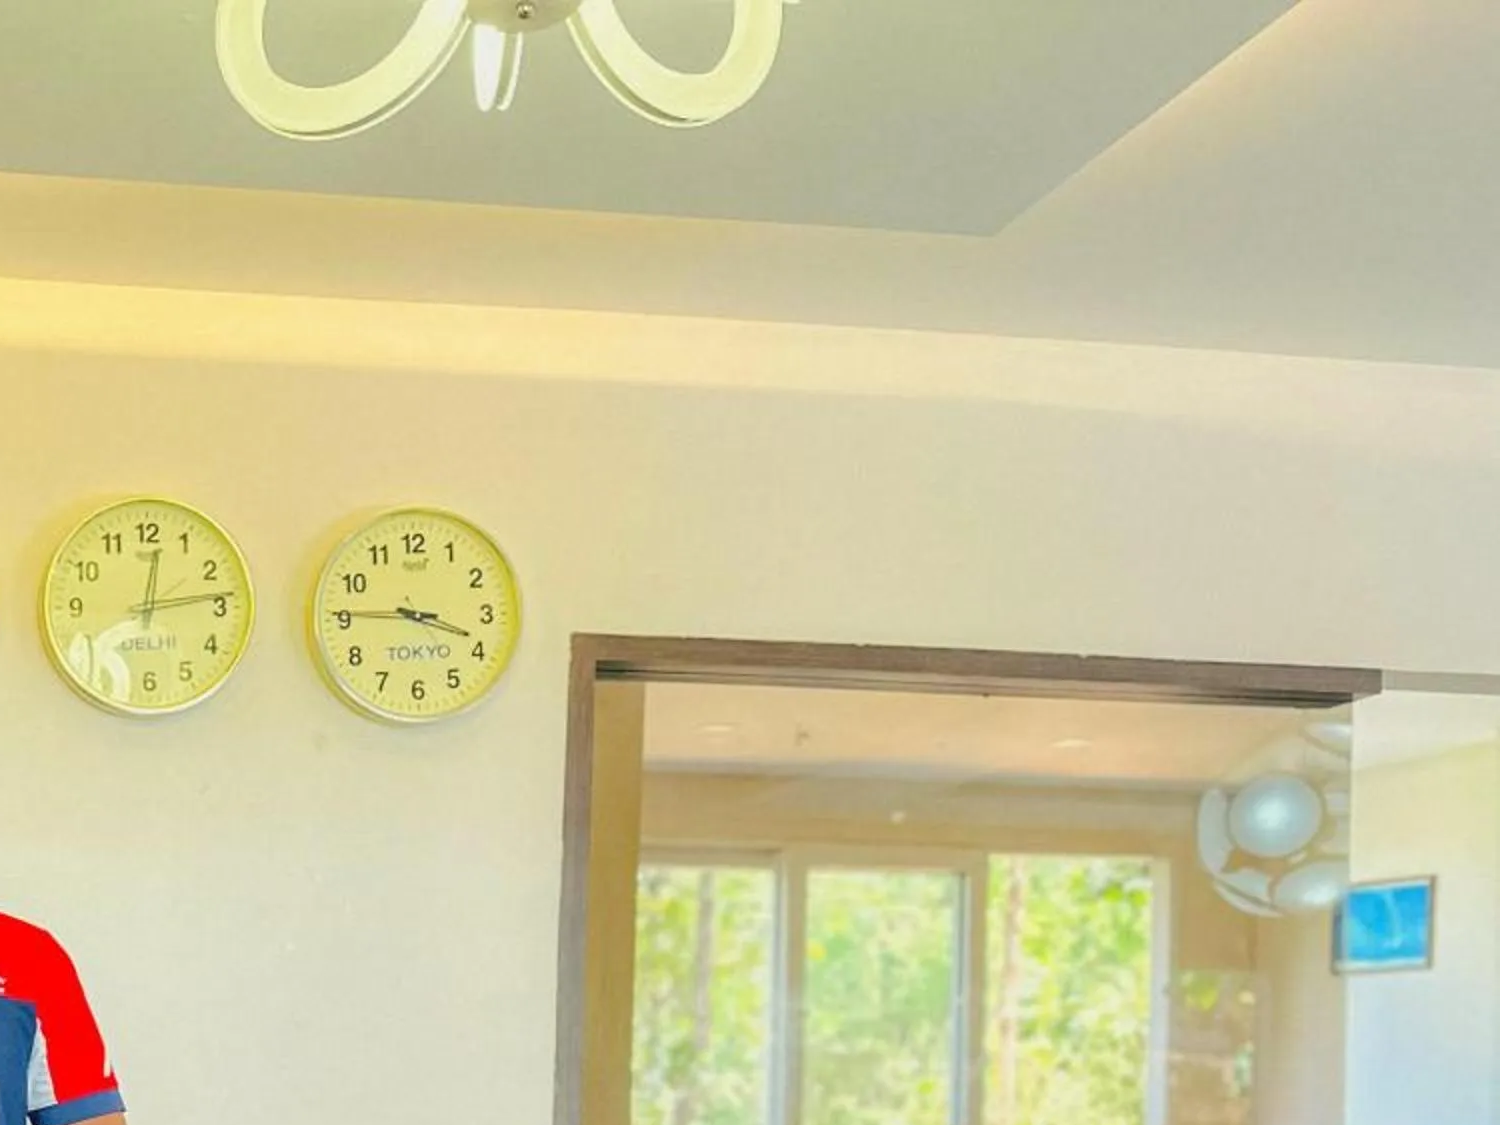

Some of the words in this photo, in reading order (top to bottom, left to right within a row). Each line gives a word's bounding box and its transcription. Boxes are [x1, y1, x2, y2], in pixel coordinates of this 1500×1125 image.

[102, 533, 121, 554] 11
[135, 523, 160, 544] 12
[179, 533, 188, 554] 1
[401, 534, 425, 554] 12
[445, 542, 453, 562] 1
[369, 545, 388, 565] 11
[76, 561, 99, 582] 10
[204, 560, 217, 581] 2
[469, 568, 483, 588] 2
[342, 574, 366, 594] 10
[70, 598, 82, 618] 9
[213, 595, 227, 617] 3
[480, 604, 494, 624] 3
[338, 610, 351, 630] 9
[121, 635, 176, 650] DELHI
[204, 634, 218, 654] 4
[387, 645, 451, 660] TOKYO
[472, 641, 485, 661] 4
[349, 646, 362, 666] 8
[143, 672, 156, 691] 6
[179, 661, 193, 682] 5
[447, 669, 460, 688] 5
[376, 672, 388, 692] 7
[411, 680, 425, 700] 6
